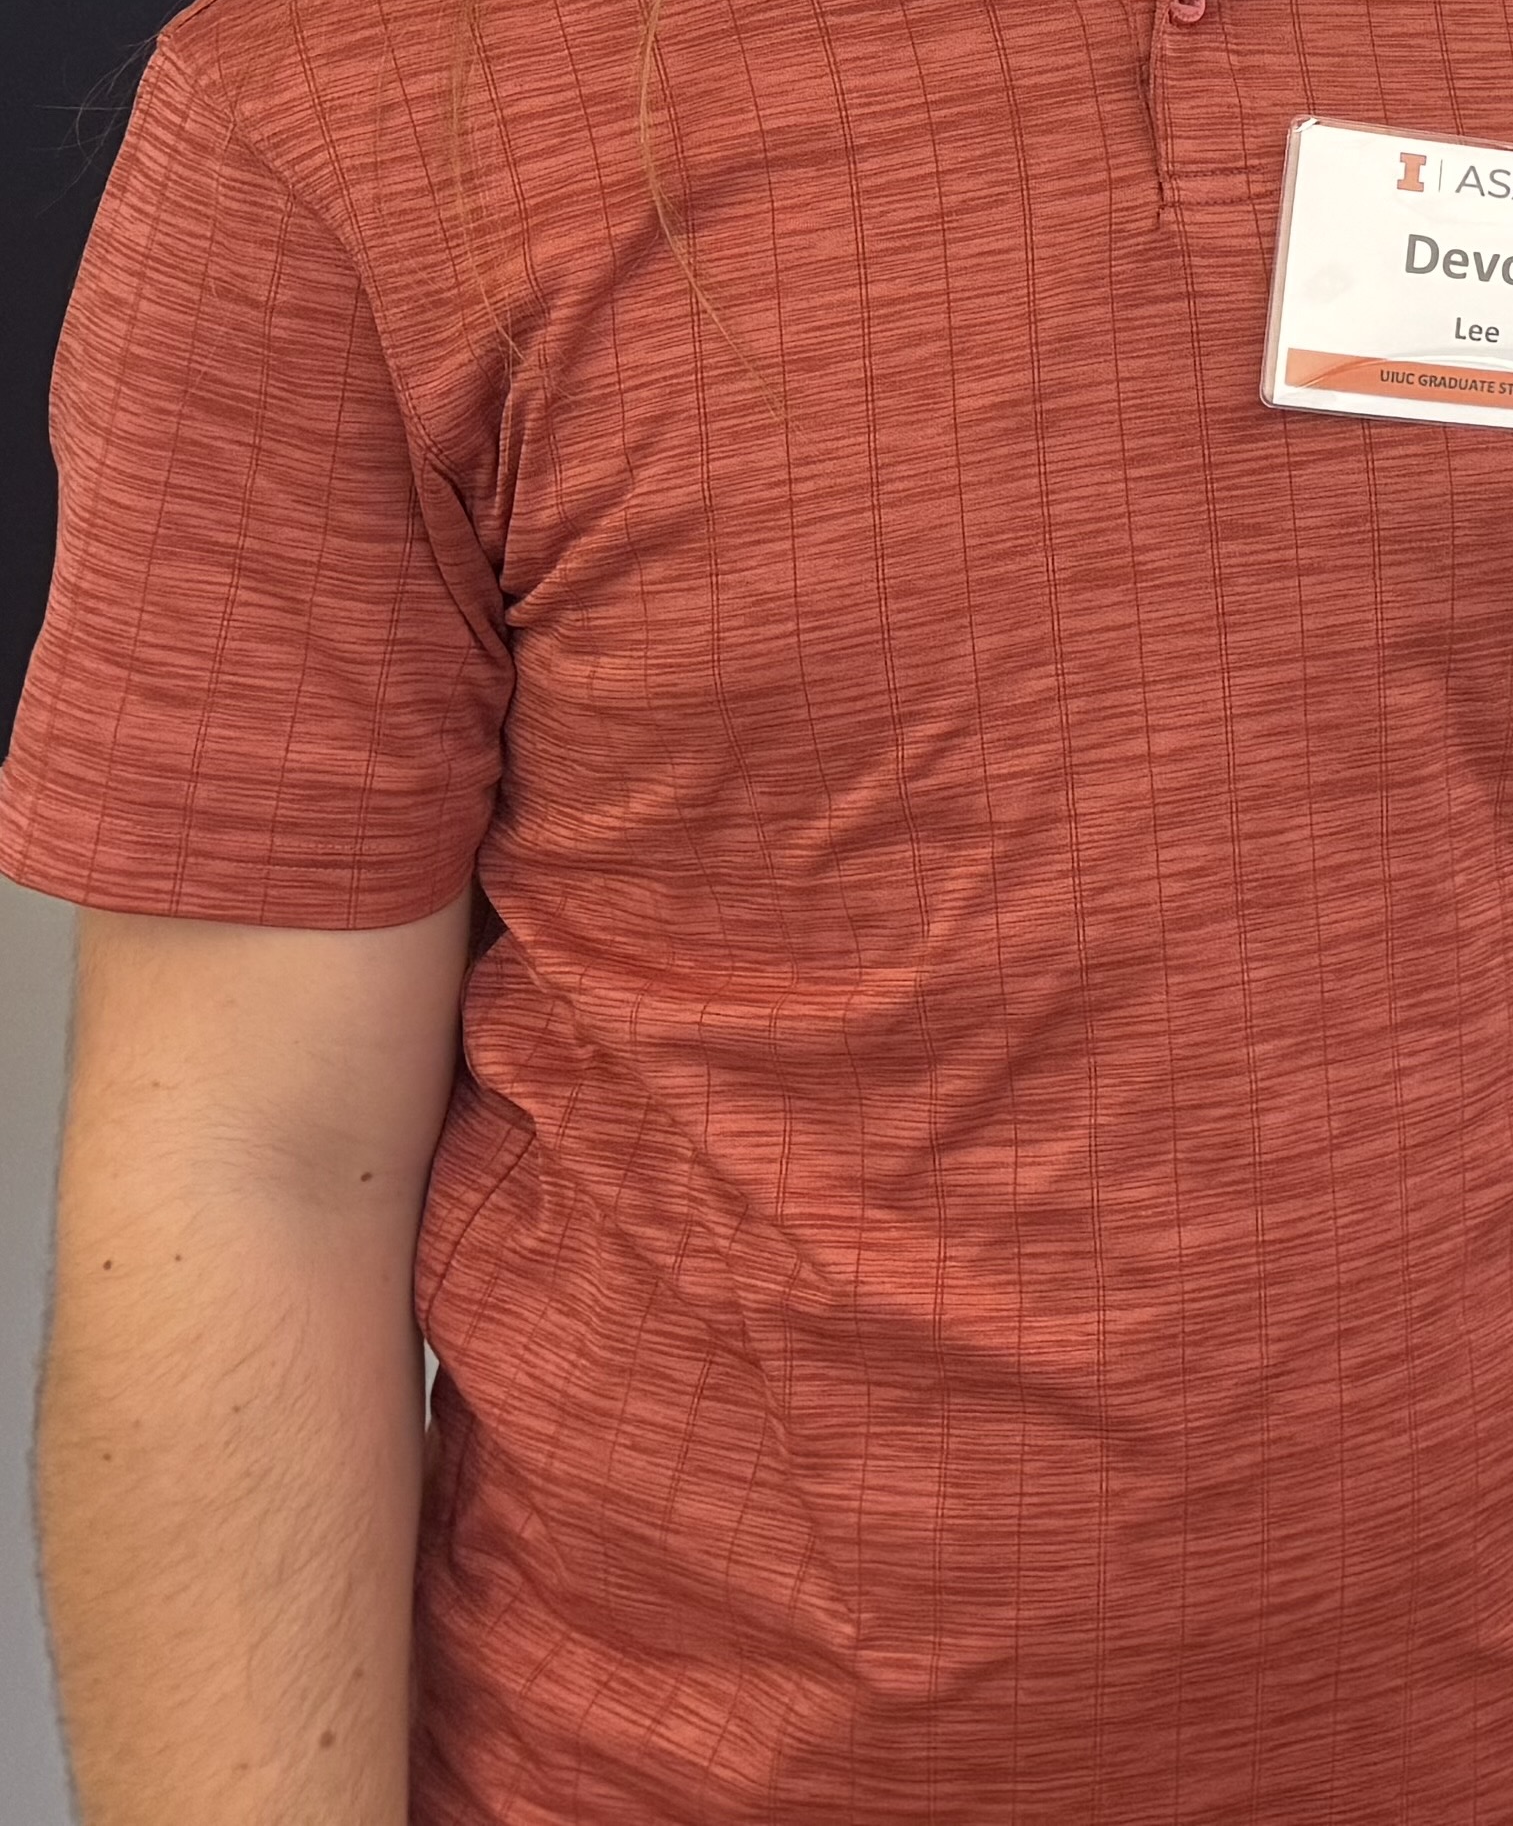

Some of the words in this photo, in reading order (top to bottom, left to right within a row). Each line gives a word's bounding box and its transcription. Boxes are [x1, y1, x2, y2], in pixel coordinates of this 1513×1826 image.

[1454, 317, 1500, 344] Lee
[1380, 369, 1415, 385] UIUC
[1418, 373, 1496, 393] GRADUATE
